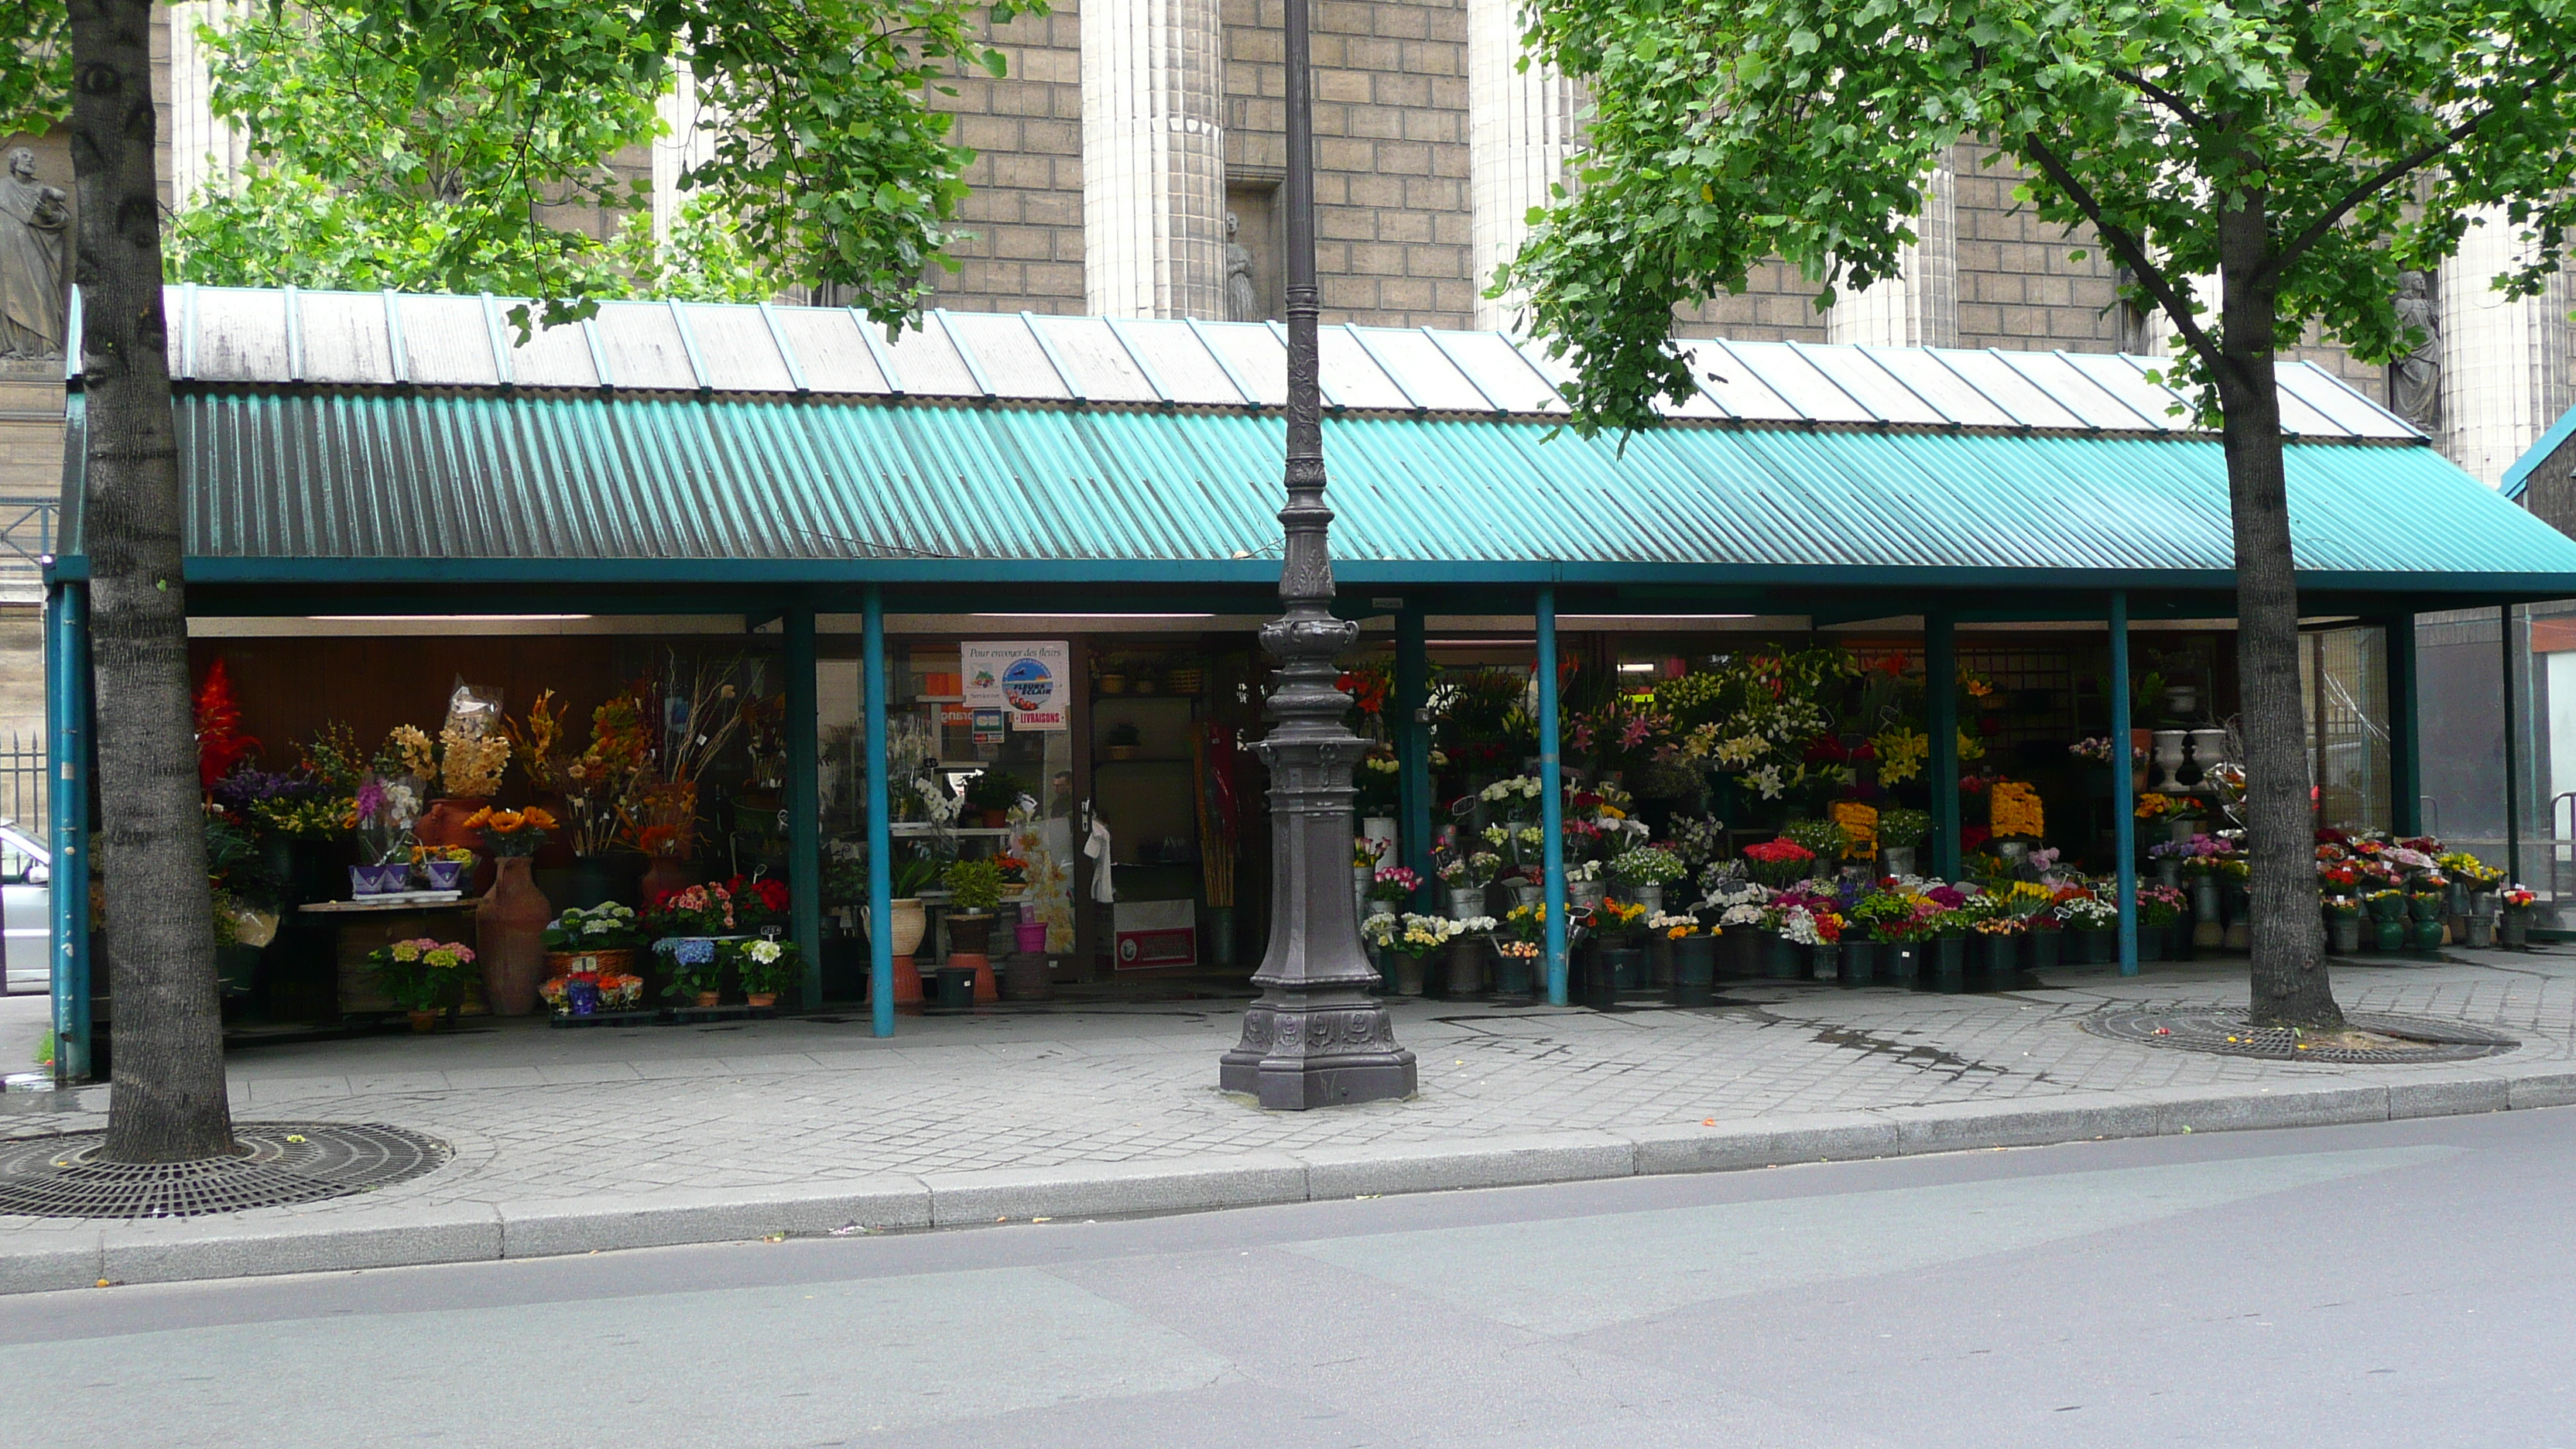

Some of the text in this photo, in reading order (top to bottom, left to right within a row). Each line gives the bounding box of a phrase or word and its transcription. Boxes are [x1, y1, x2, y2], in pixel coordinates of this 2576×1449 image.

[970, 648, 1061, 659] Pour envoyer des fleurs
[1020, 713, 1060, 724] LIVRAISONS
